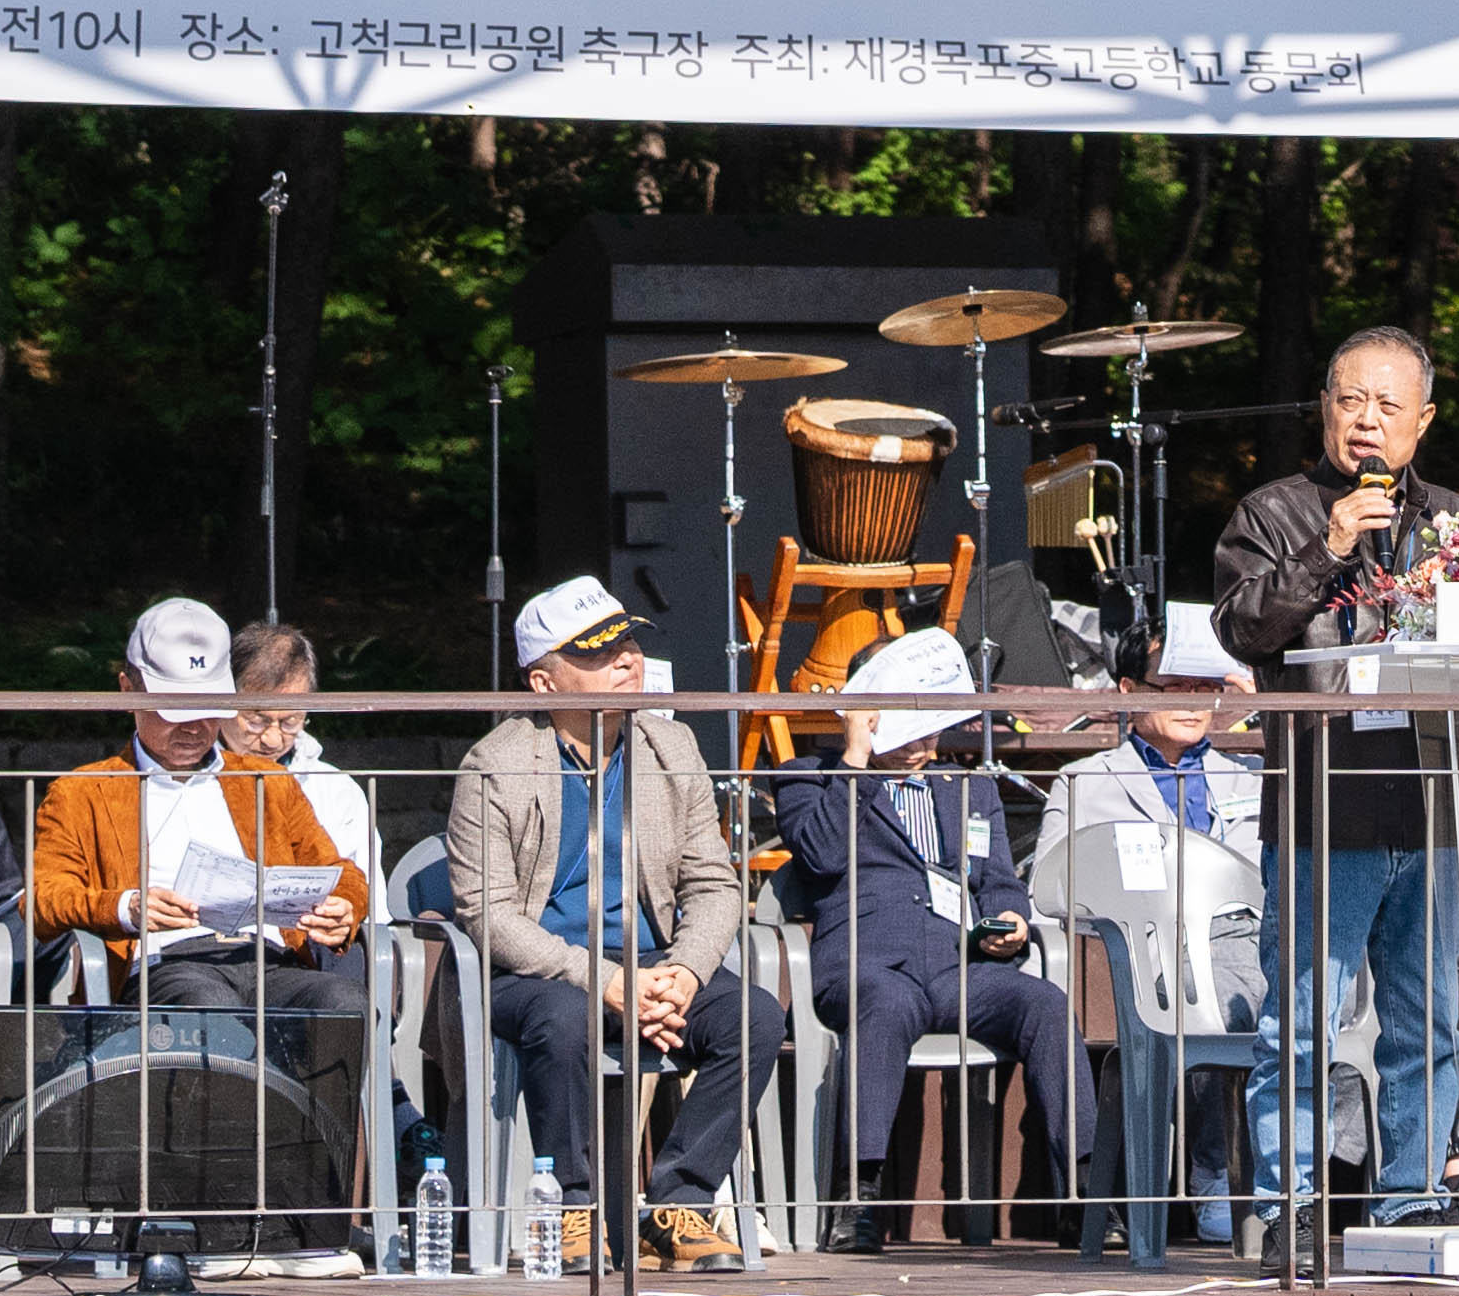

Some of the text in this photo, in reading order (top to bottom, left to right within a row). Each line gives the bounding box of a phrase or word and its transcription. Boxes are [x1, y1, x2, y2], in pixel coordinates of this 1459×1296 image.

[179, 12, 280, 62] 장소:
[305, 18, 565, 74] 고척근린공원
[578, 26, 709, 79] 축구장
[731, 33, 830, 82] 주최:
[844, 36, 1230, 91] 재경목포중고등학교
[1240, 49, 1365, 95] 동문회
[189, 656, 206, 669] M
